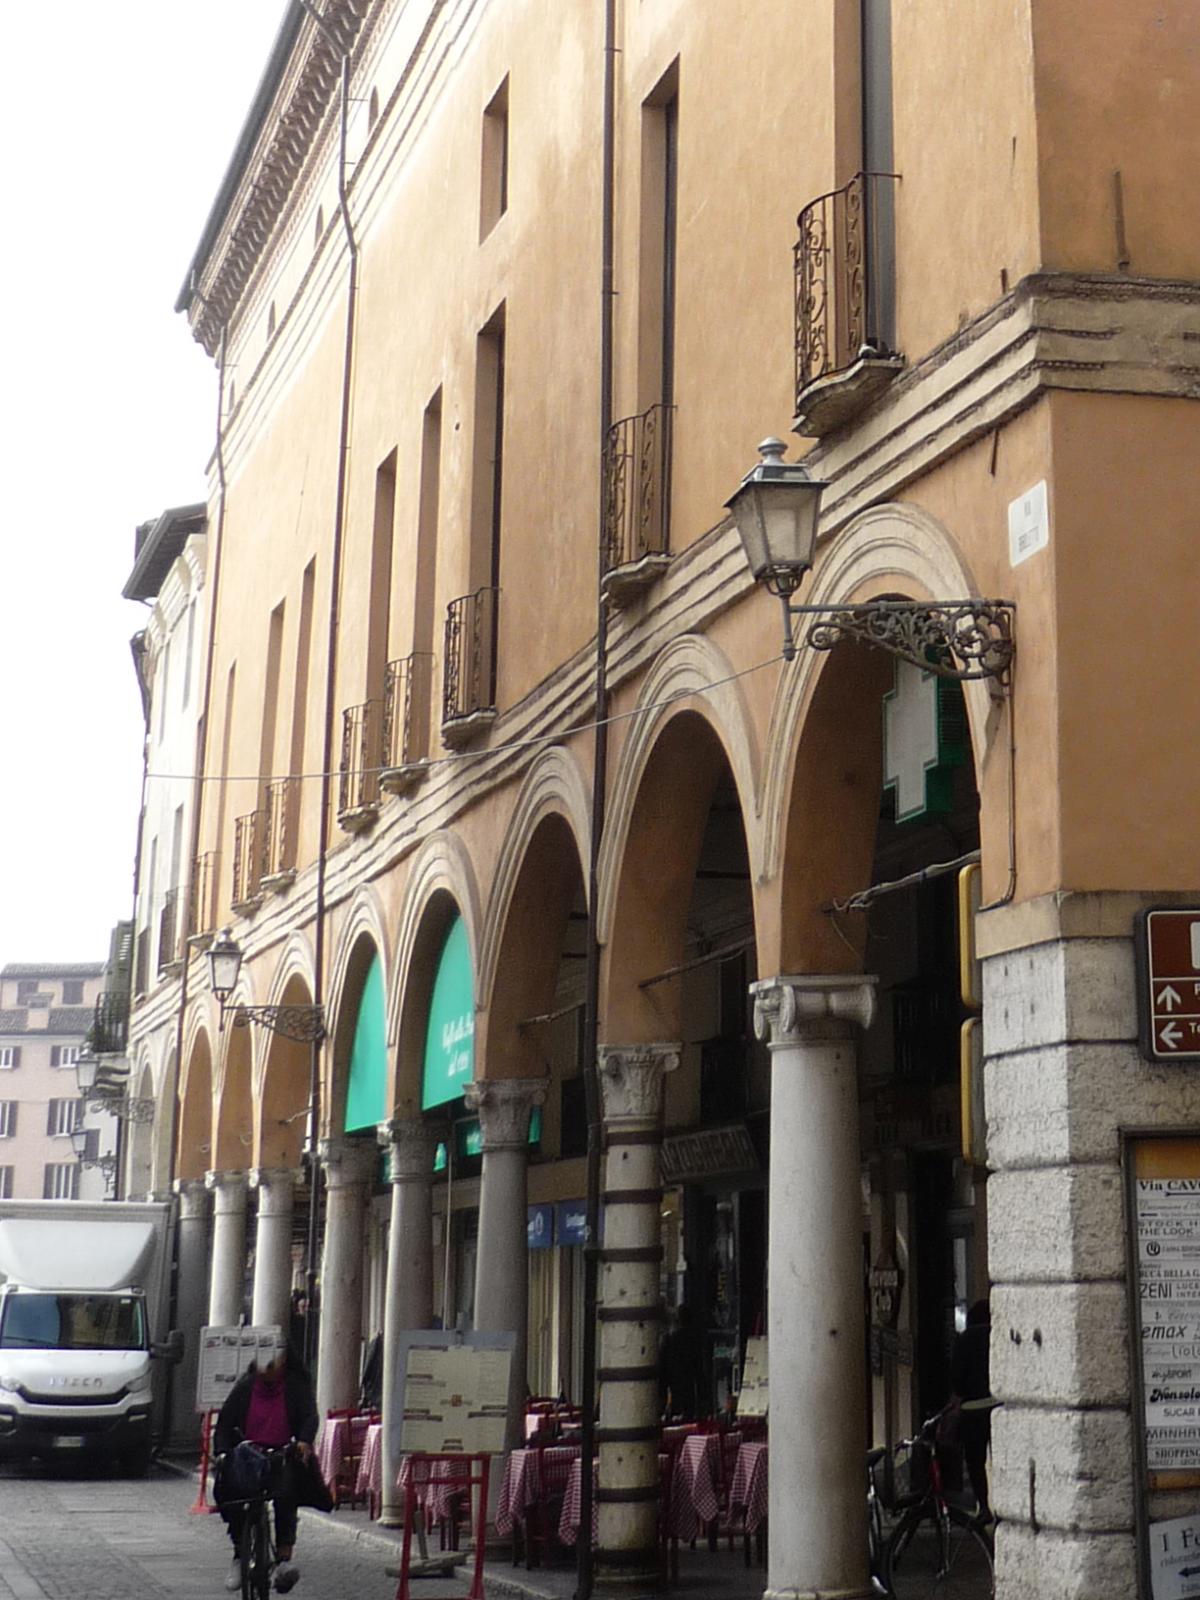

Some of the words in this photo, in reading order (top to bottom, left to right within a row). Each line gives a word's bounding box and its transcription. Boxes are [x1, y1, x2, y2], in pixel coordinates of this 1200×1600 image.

[1140, 1180, 1163, 1190] Via
[1140, 1228, 1159, 1236] THE
[1163, 1228, 1193, 1236] LOOK
[1164, 1270, 1190, 1278] DELLA
[1140, 1282, 1171, 1298] ZENI
